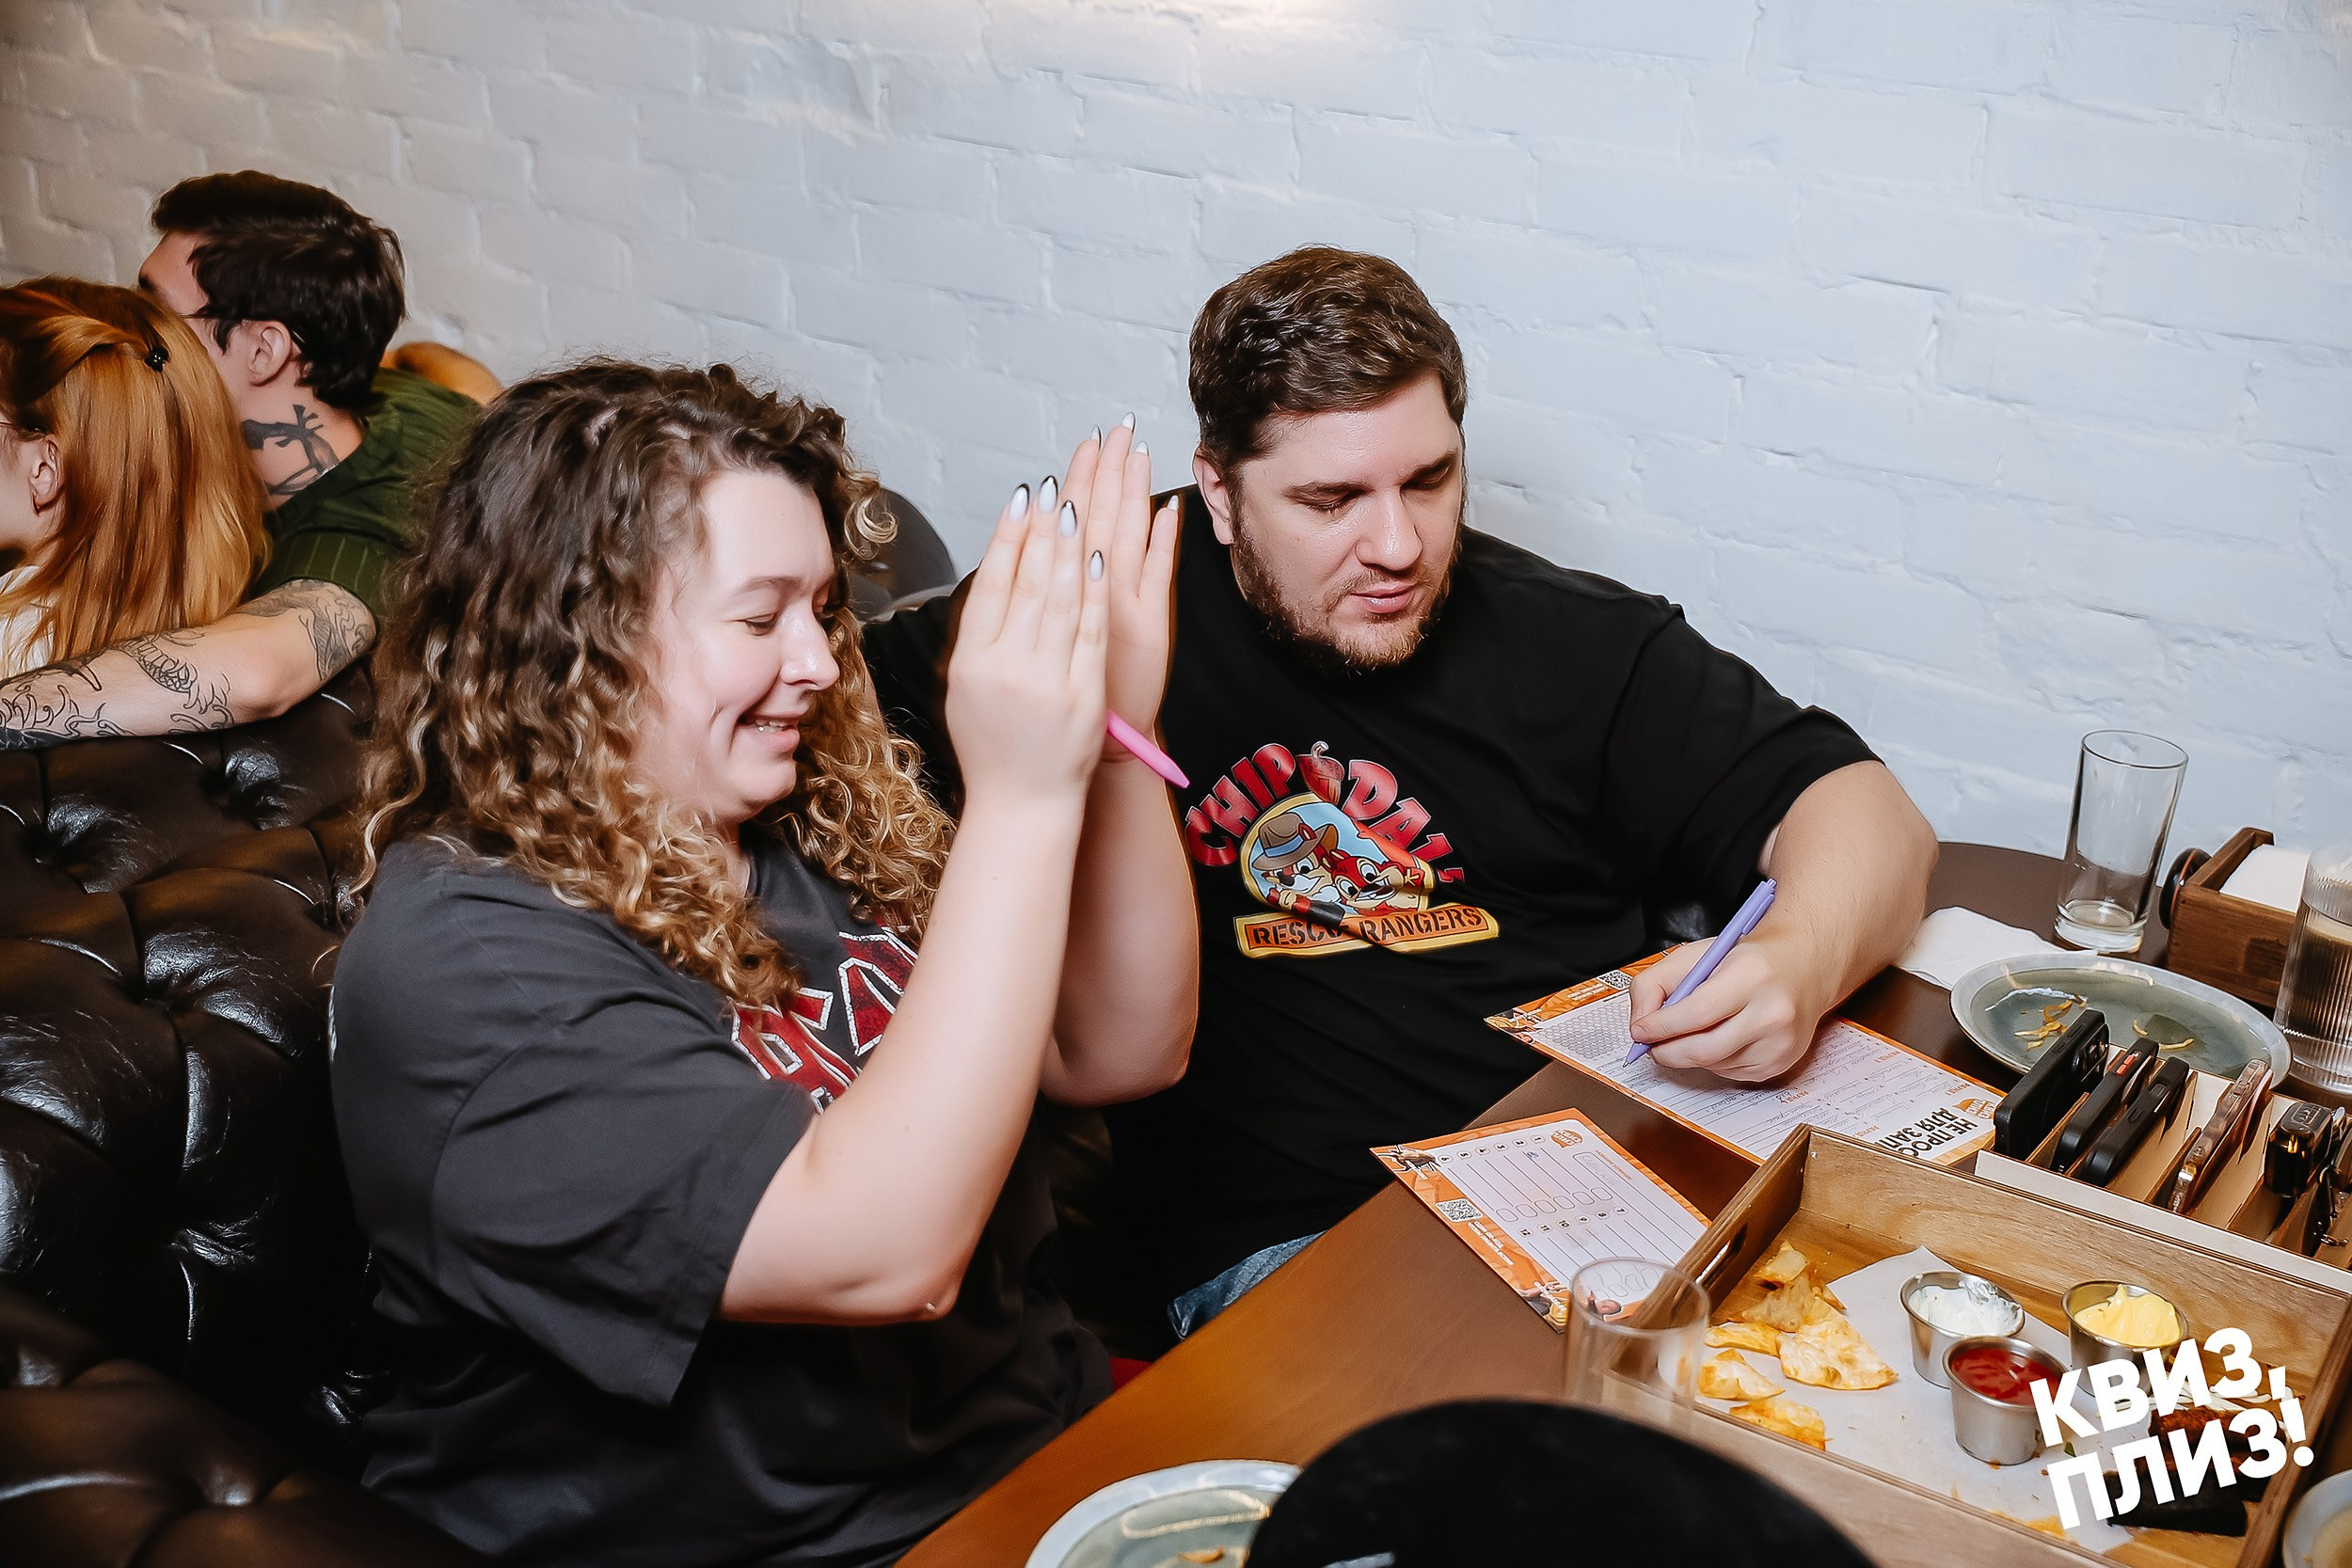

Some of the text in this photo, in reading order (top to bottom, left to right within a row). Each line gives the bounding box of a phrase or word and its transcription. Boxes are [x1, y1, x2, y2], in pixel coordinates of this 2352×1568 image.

[1184, 742, 1295, 866] CHIP
[1359, 907, 1483, 942] RANGERS
[1874, 1107, 1959, 1149] ДЛЯ ЗАП
[1898, 1118, 1979, 1158] НЕ ПРОС
